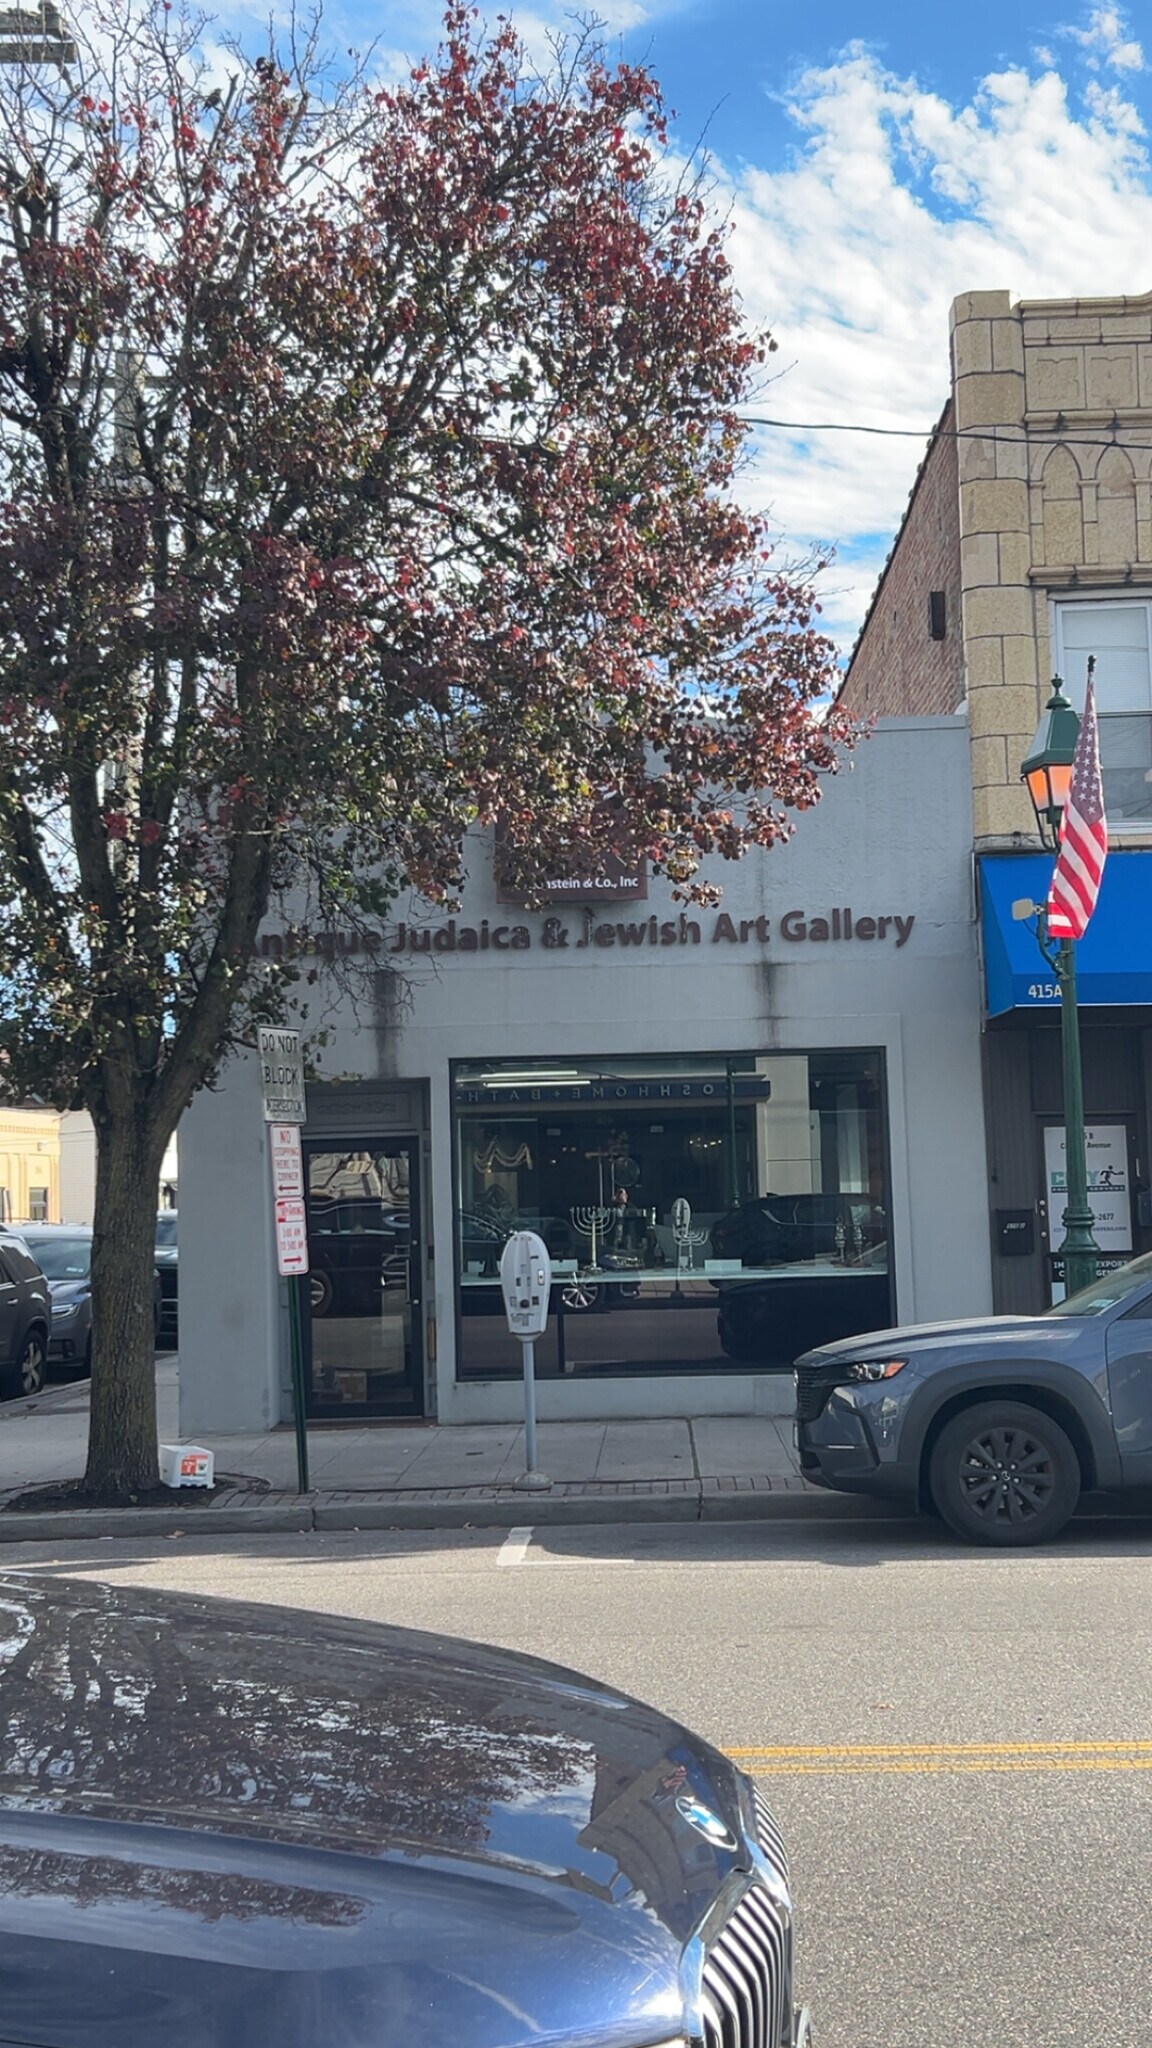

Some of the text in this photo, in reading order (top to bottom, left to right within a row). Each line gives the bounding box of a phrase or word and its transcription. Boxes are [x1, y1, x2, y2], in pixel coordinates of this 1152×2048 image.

[582, 877, 593, 888] &
[619, 875, 639, 888] Inc
[391, 919, 531, 952] Judaica
[541, 917, 569, 949] &
[576, 912, 701, 948] Jewish
[712, 912, 770, 943] Art
[780, 908, 915, 948] Gallery
[1028, 984, 1062, 998] 415A
[261, 1033, 298, 1053] DO NOT
[264, 1066, 299, 1085] BLOCK
[280, 1130, 291, 1144] NO
[347, 1160, 373, 1173] 417
[277, 1171, 299, 1182] CORNER
